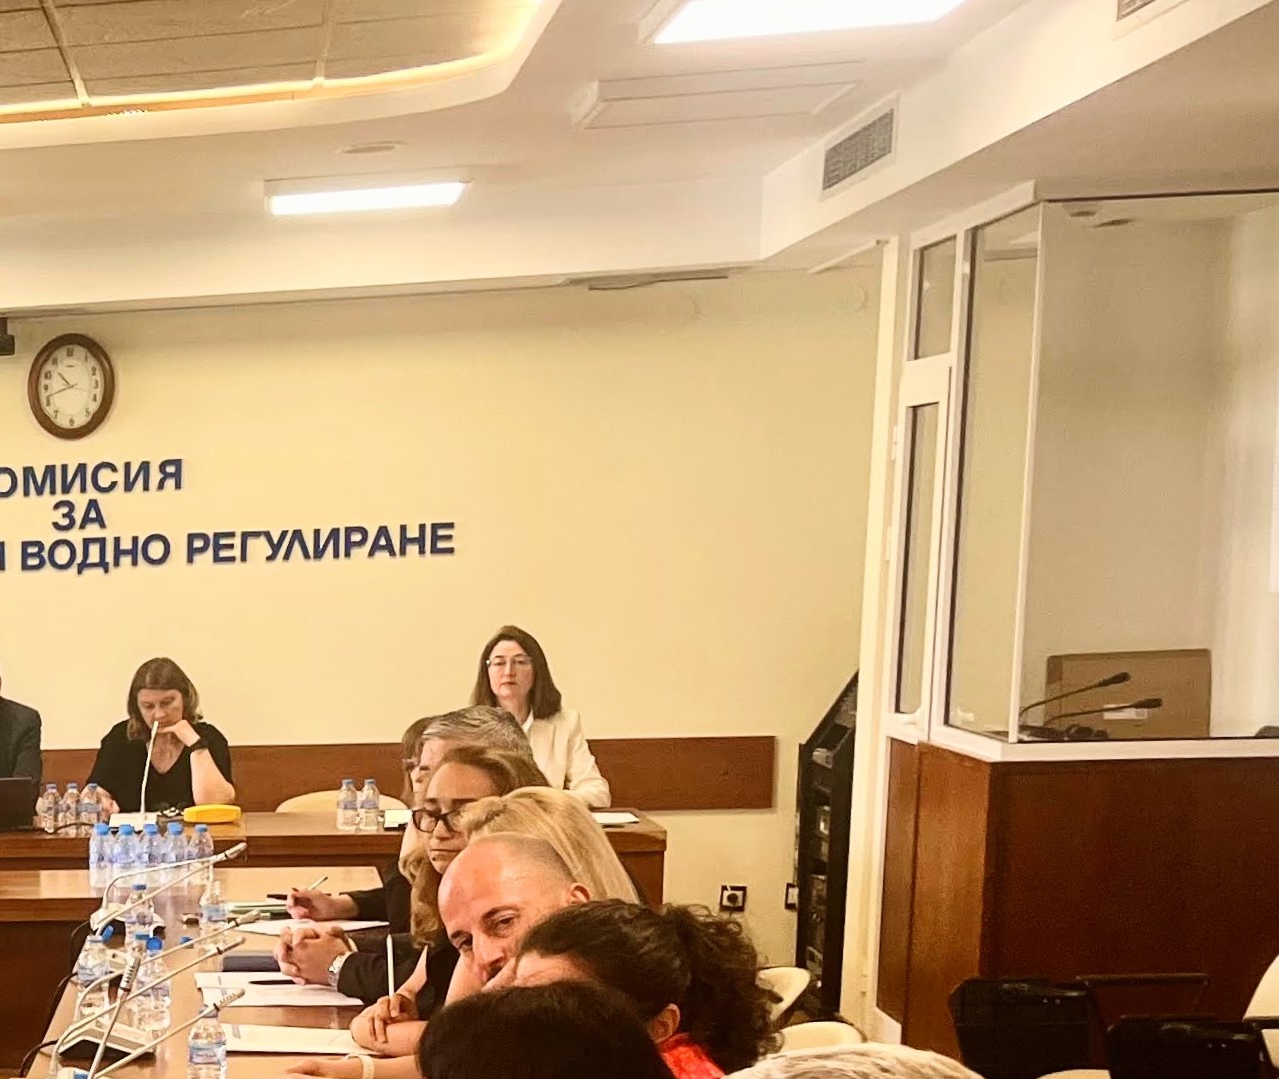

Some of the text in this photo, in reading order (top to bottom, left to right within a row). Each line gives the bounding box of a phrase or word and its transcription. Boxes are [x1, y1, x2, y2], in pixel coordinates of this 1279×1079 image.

[51, 498, 108, 532] ЗА
[20, 533, 172, 576] ВОДНО
[186, 521, 456, 565] РЕГУЛИРАНЕ
